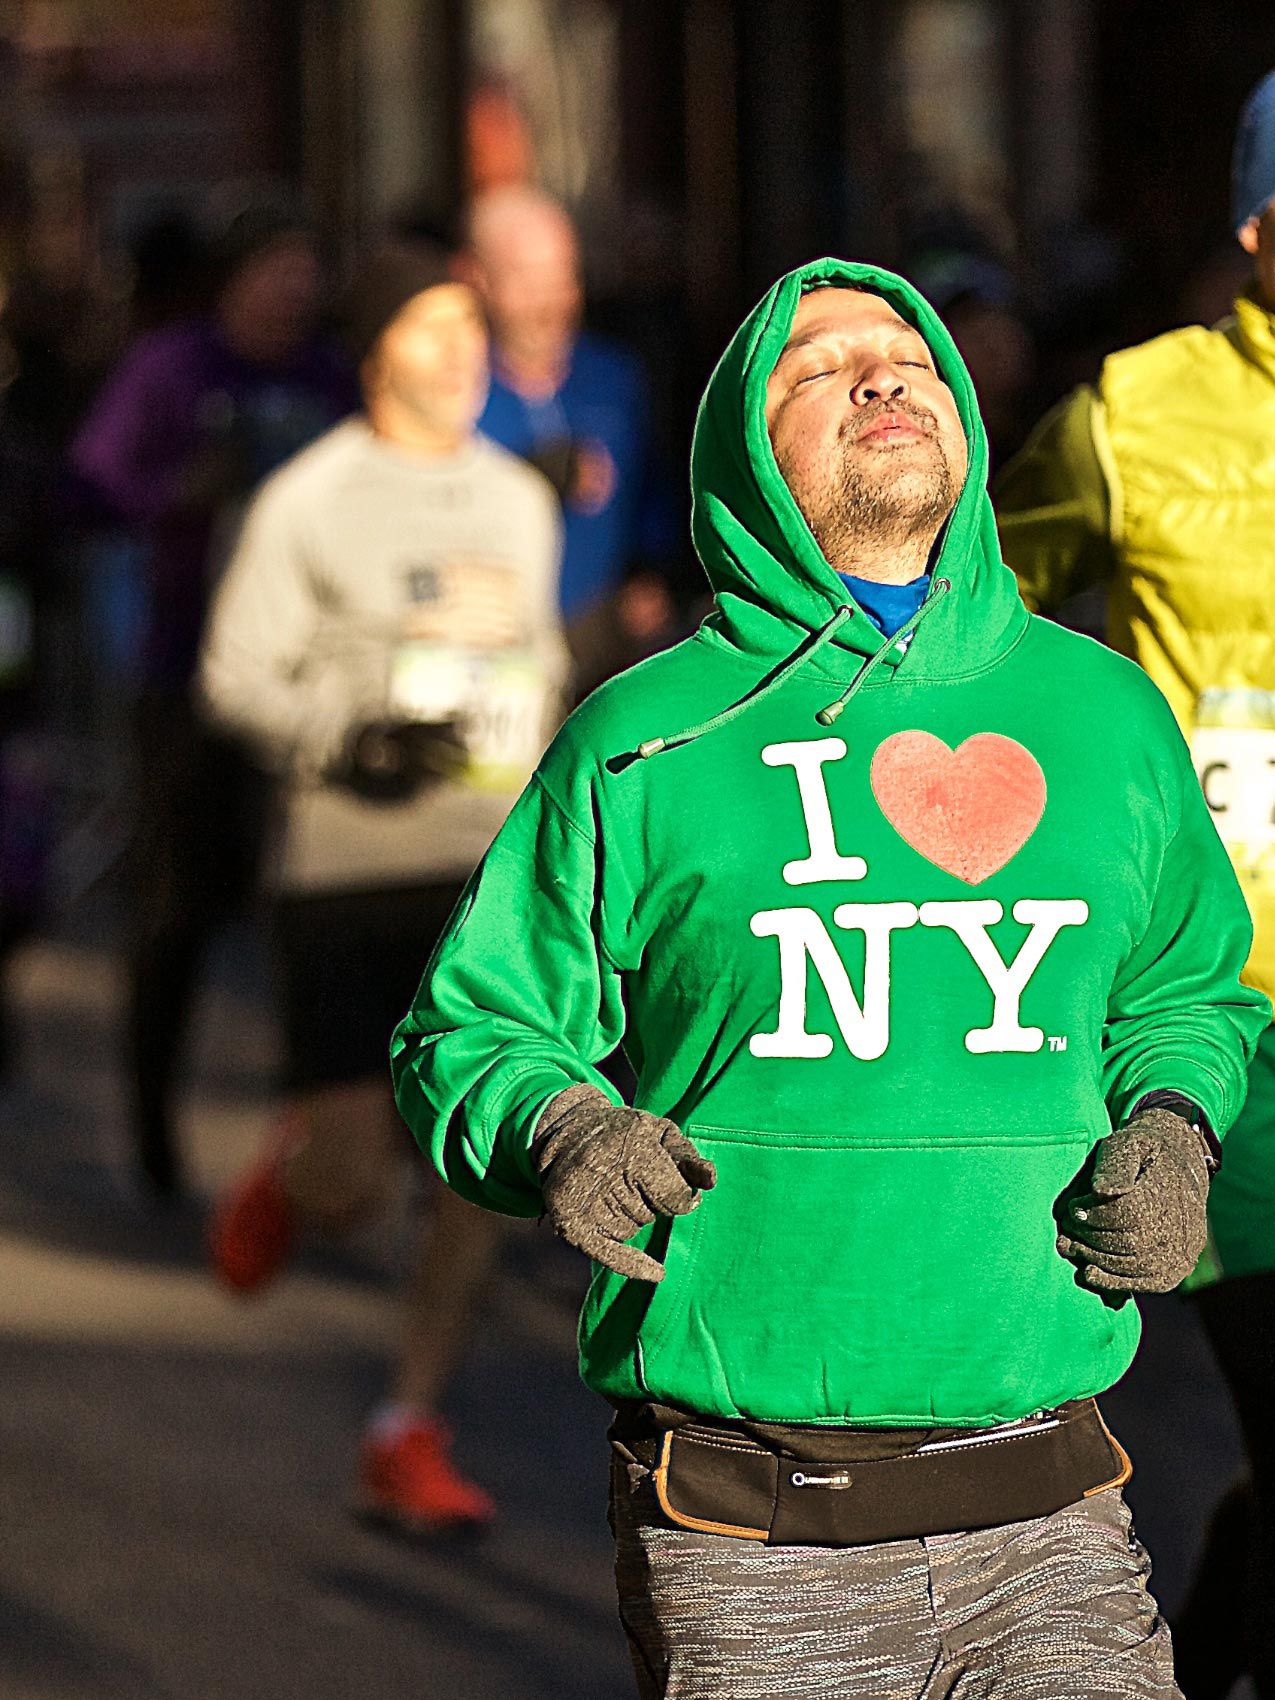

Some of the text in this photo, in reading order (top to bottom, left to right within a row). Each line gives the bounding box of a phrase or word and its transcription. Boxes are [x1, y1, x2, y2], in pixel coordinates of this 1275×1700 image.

[761, 737, 867, 885] I
[1201, 761, 1229, 813] C
[750, 899, 1089, 1060] NY
